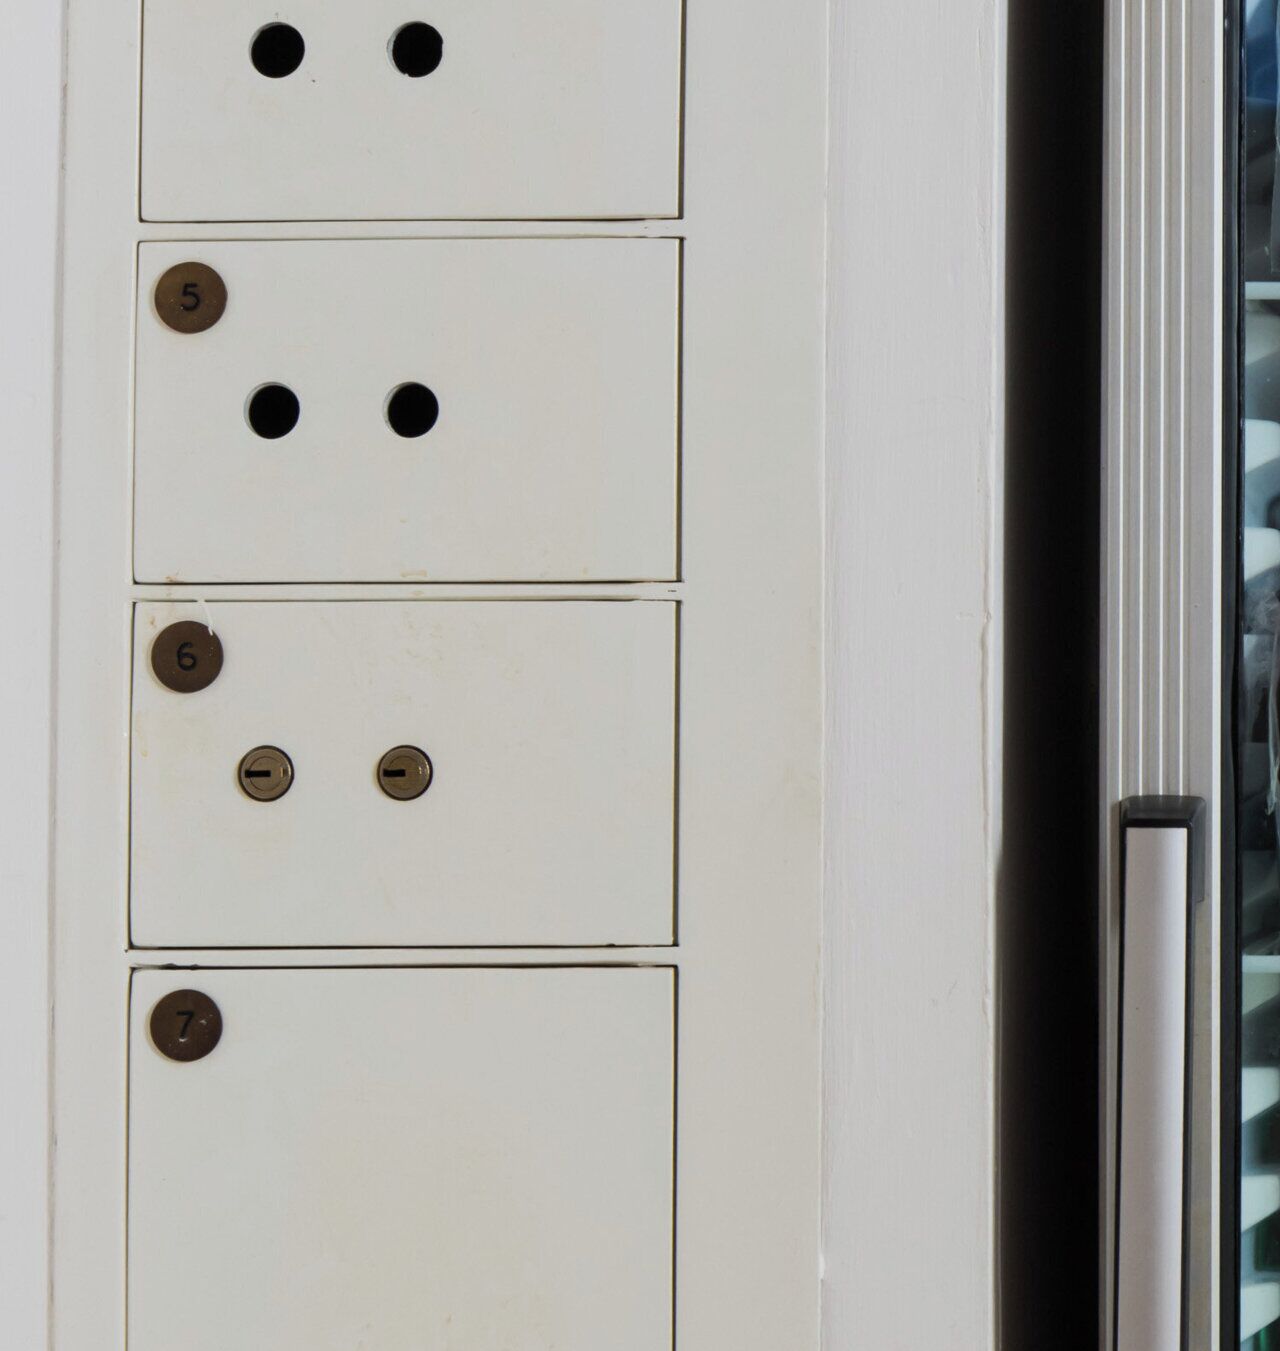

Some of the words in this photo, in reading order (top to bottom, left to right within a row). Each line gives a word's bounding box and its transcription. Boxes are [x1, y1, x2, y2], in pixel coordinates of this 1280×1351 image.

[180, 283, 200, 312] 5
[176, 642, 197, 672] 6
[176, 1011, 196, 1039] 7
